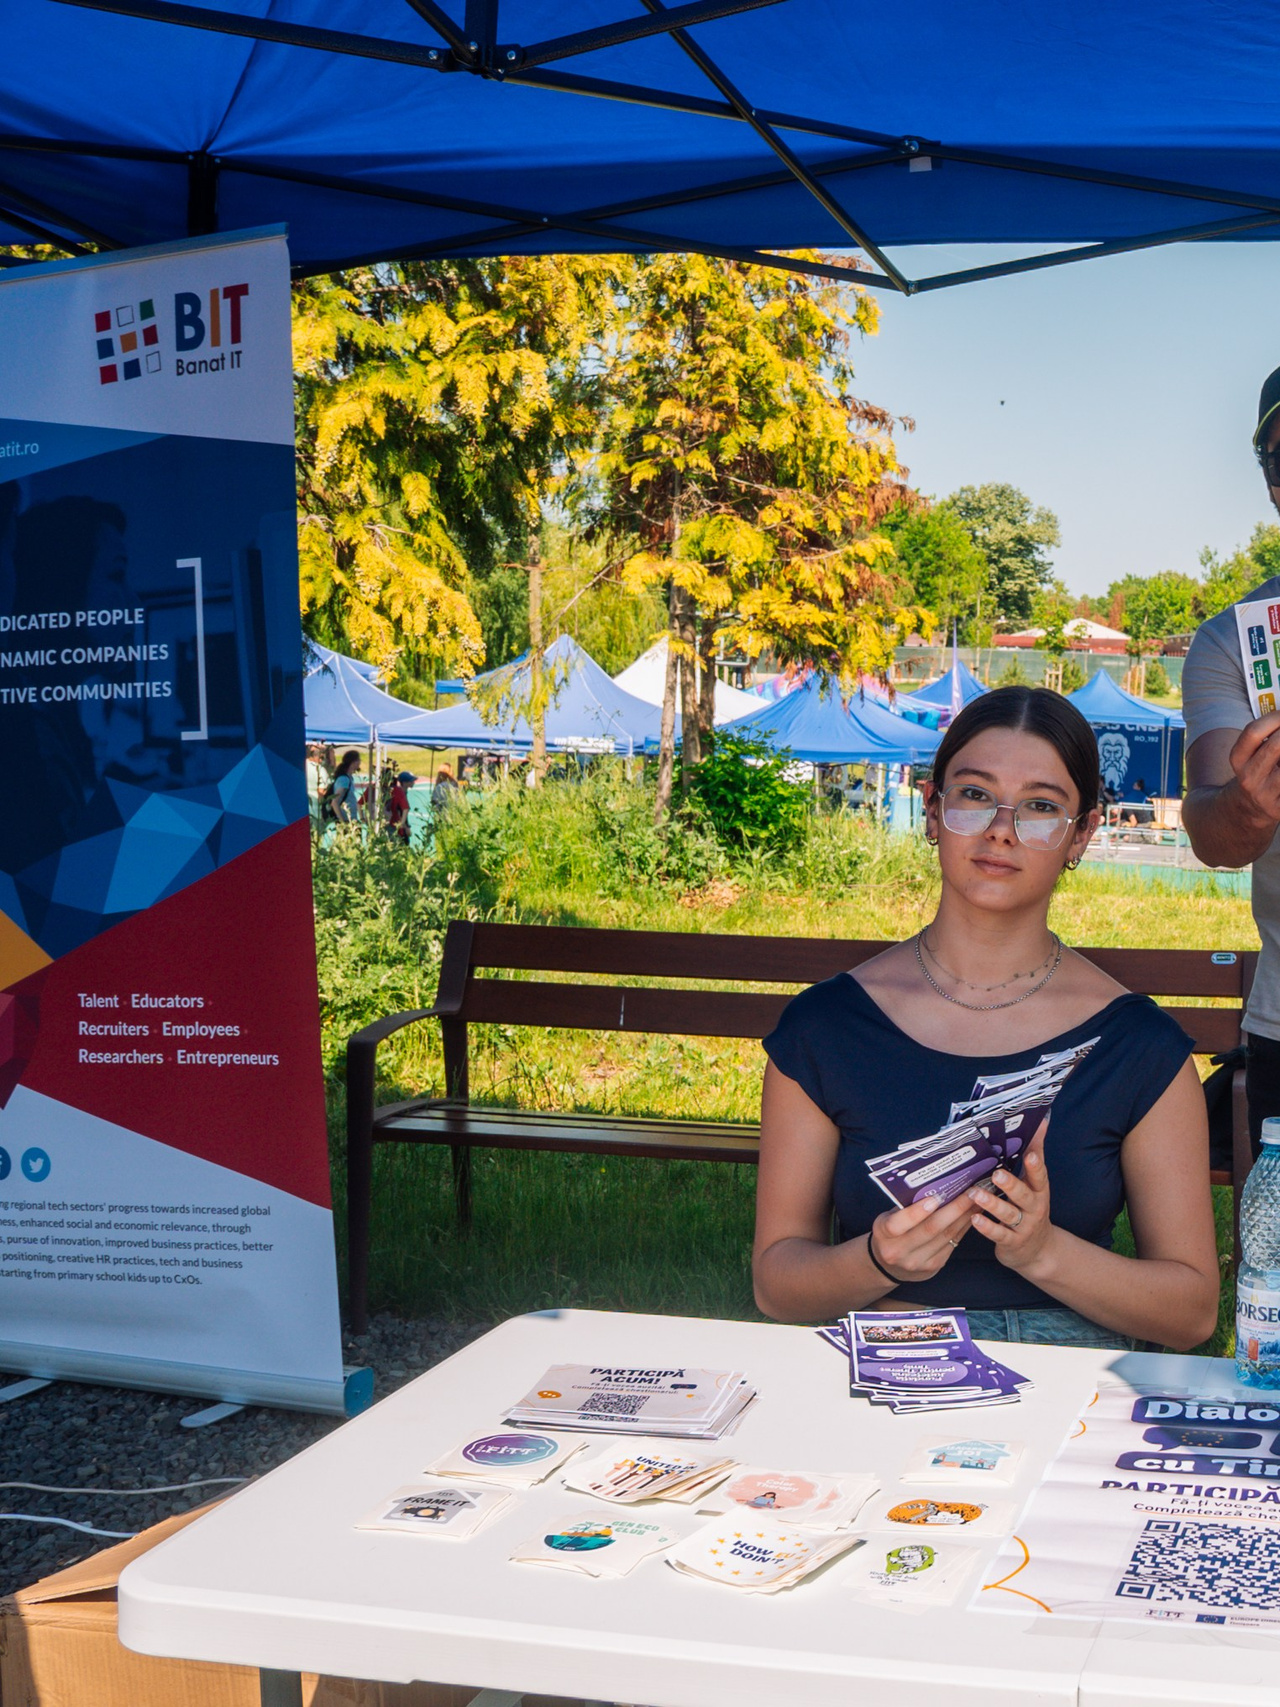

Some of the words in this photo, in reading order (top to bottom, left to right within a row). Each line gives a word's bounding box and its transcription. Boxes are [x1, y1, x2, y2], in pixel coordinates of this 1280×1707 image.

[174, 283, 249, 352] BIT
[176, 353, 227, 377] Banat
[230, 350, 244, 370] IT
[0, 612, 71, 632] DICATED
[75, 607, 145, 627] PEOPLE
[0, 649, 57, 668] NAMIC
[60, 644, 169, 664] COMPANIES
[0, 687, 37, 704] TIVE
[41, 681, 172, 702] COMMUNITIES
[77, 993, 119, 1008] Talent
[131, 993, 204, 1008] Educators
[78, 1021, 149, 1036] Recruiters
[162, 1021, 240, 1040] Employees
[78, 1048, 163, 1064] Researchers
[177, 1049, 279, 1068] Entrepreneurs
[11, 1201, 46, 1212] regional
[48, 1201, 68, 1211] tech
[70, 1202, 106, 1212] sectors'
[108, 1204, 149, 1214] progress
[151, 1204, 190, 1214] towards
[192, 1204, 239, 1215] increased
[241, 1206, 271, 1218] global
[20, 1218, 64, 1228] enhanced
[66, 1219, 92, 1229] social
[94, 1220, 112, 1230] and
[113, 1221, 159, 1231] economic
[161, 1222, 211, 1233] relevance,
[212, 1223, 251, 1235] through
[7, 1236, 38, 1246] pursue
[40, 1235, 49, 1245] of
[51, 1236, 103, 1248] innovation,
[105, 1237, 149, 1249] improved
[151, 1239, 192, 1250] business
[193, 1240, 241, 1252] practices,
[242, 1241, 273, 1251] better
[2, 1252, 55, 1264] positioning,
[57, 1253, 94, 1263] creative
[96, 1255, 111, 1264] HR
[113, 1255, 158, 1266] practices,
[159, 1257, 180, 1267] tech
[182, 1258, 199, 1268] and
[201, 1258, 243, 1269] business
[33, 1269, 56, 1279] from
[58, 1270, 94, 1282] primary
[95, 1272, 125, 1282] school
[127, 1272, 147, 1282] kids
[149, 1275, 160, 1284] up
[162, 1276, 172, 1284] to
[174, 1274, 202, 1285] CxOs.
[590, 1368, 686, 1378] PARTICIPĂ
[600, 1376, 661, 1384] ACUM!
[636, 1455, 682, 1470] UNITED
[1133, 1458, 1195, 1472] cu
[757, 1482, 799, 1492] Therapy
[403, 1497, 455, 1505] FRAME
[1213, 1502, 1263, 1511] vocea
[1133, 1503, 1243, 1517] Completează
[615, 1527, 646, 1535] CLUB
[733, 1540, 774, 1555] HOW
